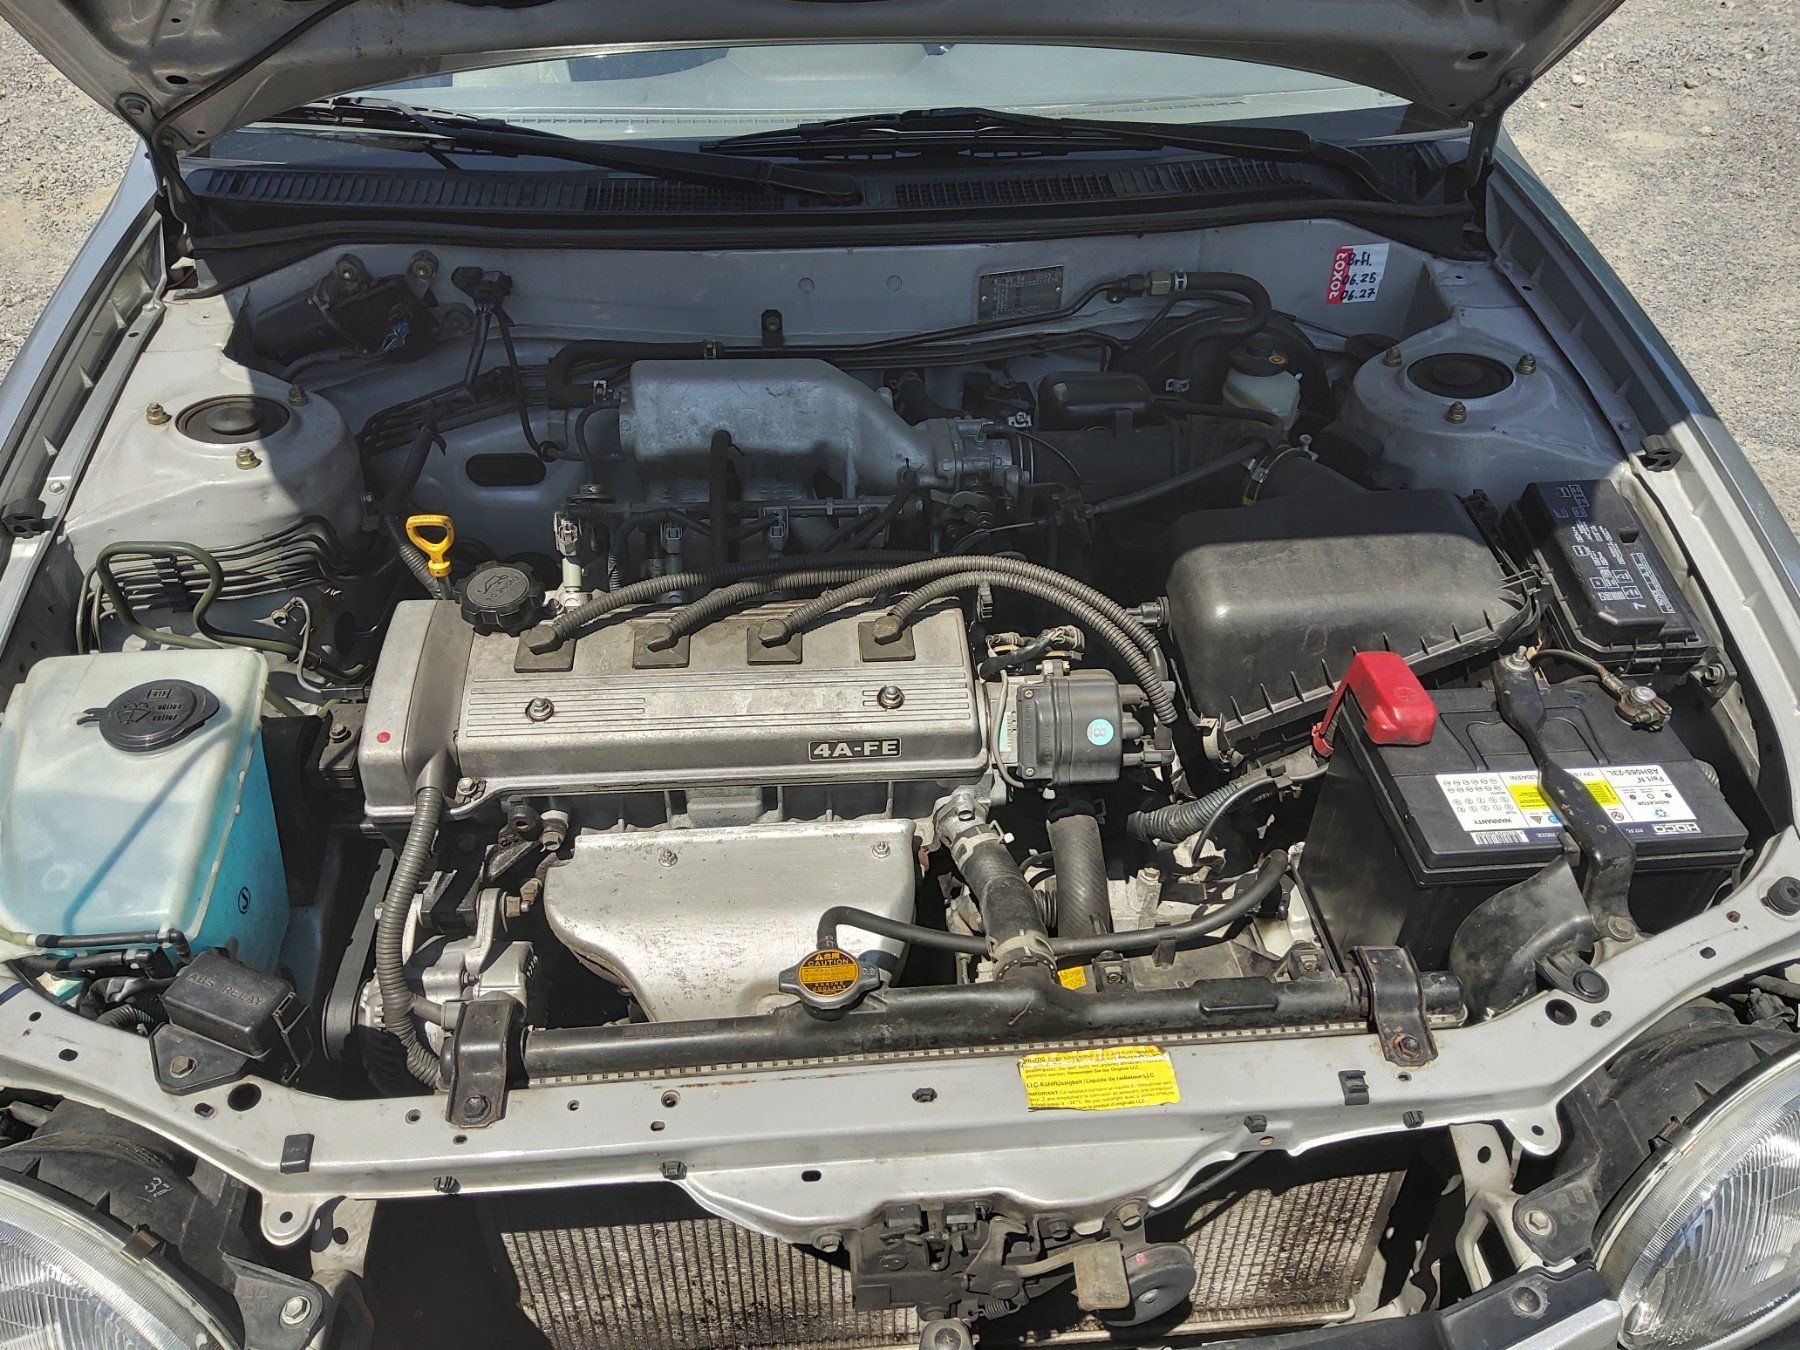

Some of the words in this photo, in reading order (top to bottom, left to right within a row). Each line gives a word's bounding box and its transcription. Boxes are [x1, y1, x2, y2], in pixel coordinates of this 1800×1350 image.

[1329, 252, 1347, 300] ROXOR
[1342, 272, 1376, 286] 06.25
[1341, 288, 1375, 301] 06.27
[813, 741, 898, 758] 4A-FE
[1647, 775, 1664, 783] Part
[1651, 822, 1702, 834] HOCO
[807, 958, 849, 967] CAUTION
[186, 972, 217, 988] ABS
[220, 986, 266, 1006] RELAY
